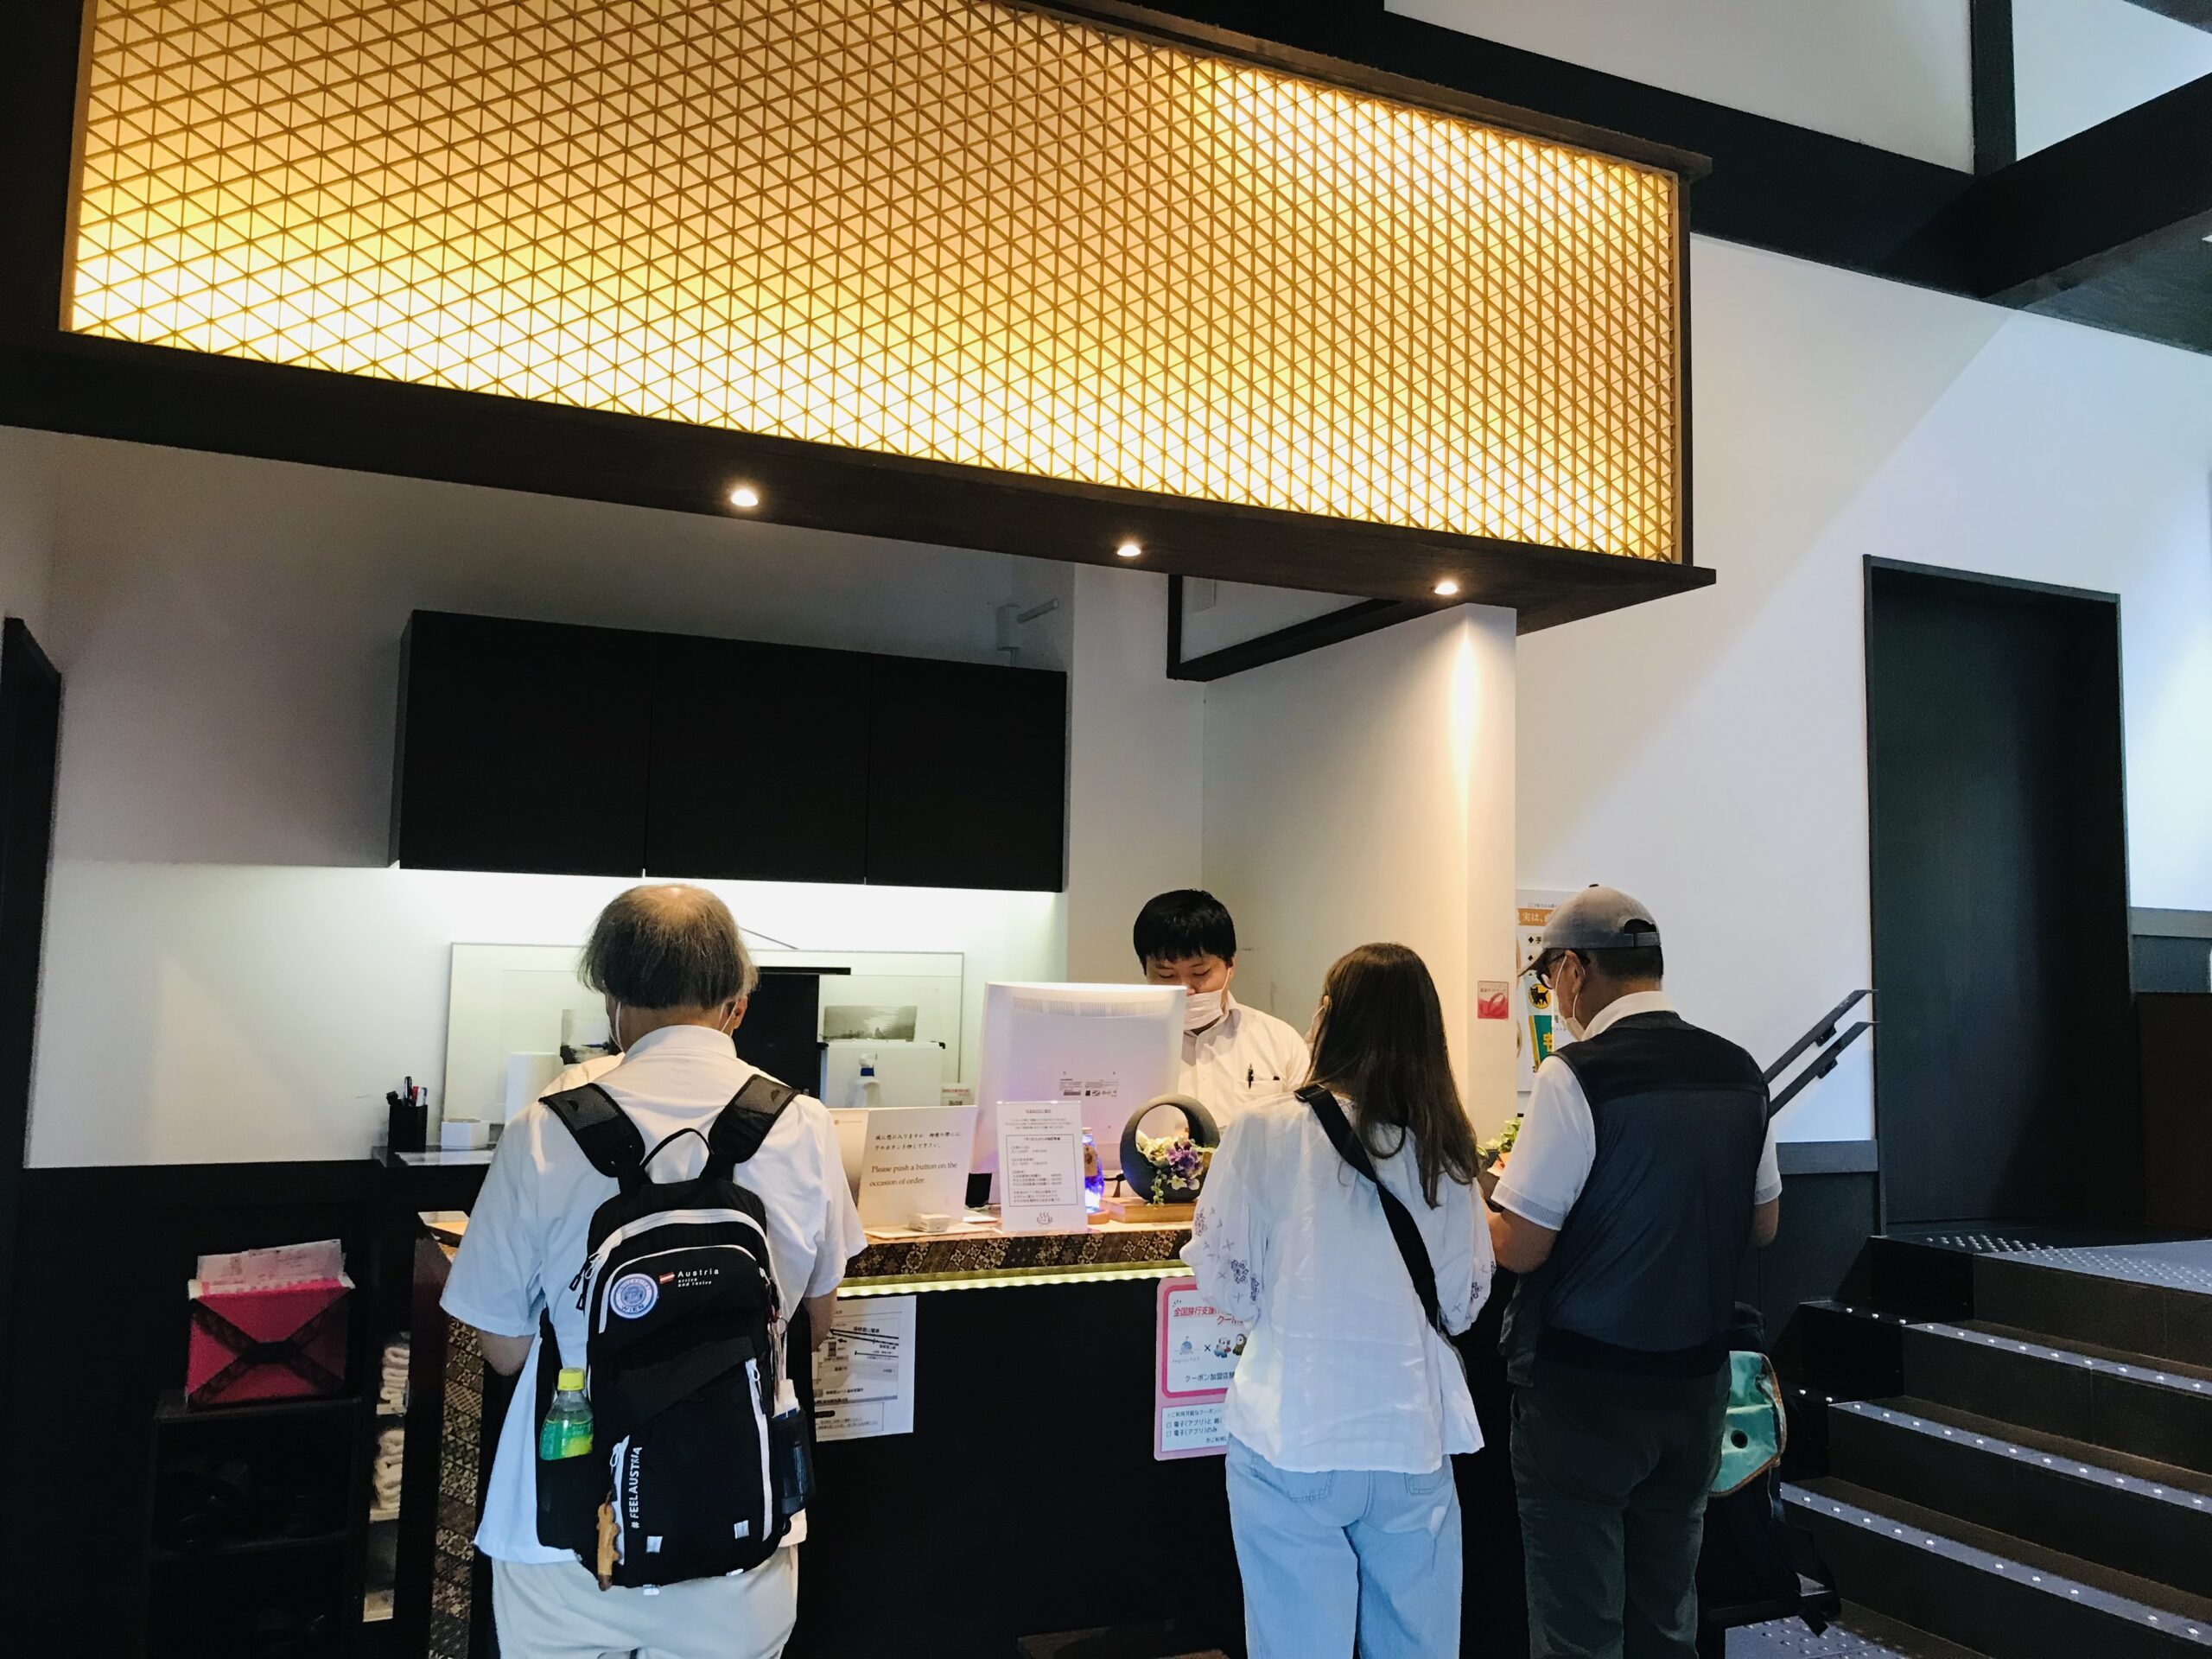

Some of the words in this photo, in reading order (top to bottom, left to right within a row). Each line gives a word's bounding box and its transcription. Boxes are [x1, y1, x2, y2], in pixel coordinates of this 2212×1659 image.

[871, 1165, 892, 1173] Please
[893, 1165, 910, 1173] push
[869, 1179, 898, 1187] occasion
[677, 1268, 720, 1278] Austria
[621, 1303, 645, 1313] WIEN
